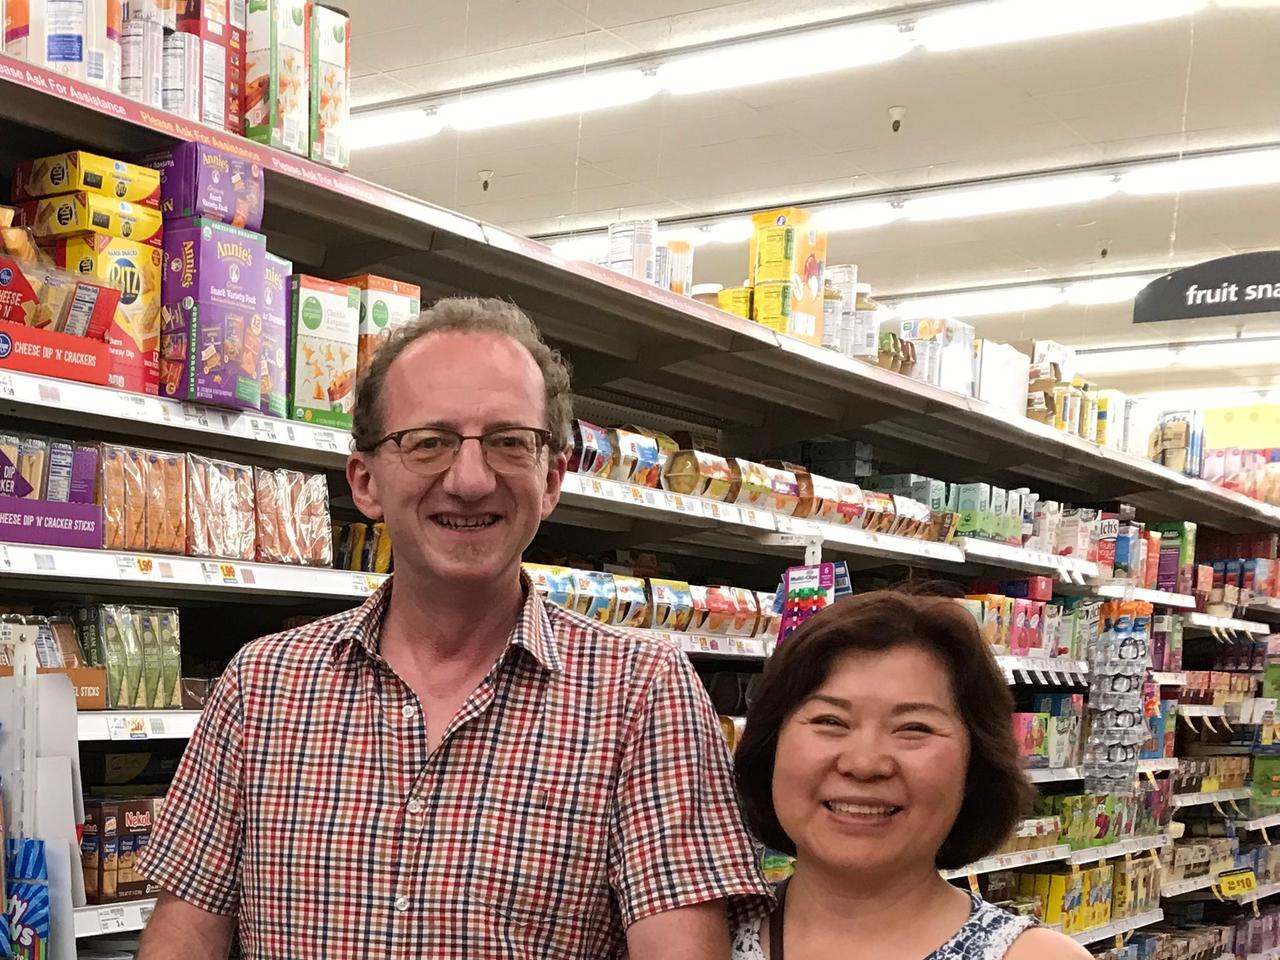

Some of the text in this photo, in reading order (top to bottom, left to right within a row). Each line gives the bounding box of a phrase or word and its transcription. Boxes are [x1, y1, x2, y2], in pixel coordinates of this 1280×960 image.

[26, 68, 48, 88] Ask
[48, 74, 67, 95] For
[69, 83, 127, 117] Assistance
[140, 109, 170, 133] Please
[173, 120, 194, 140] Ask
[210, 133, 261, 163] Assistance
[202, 152, 230, 173] Annie's
[183, 240, 198, 288] Annie's
[216, 240, 253, 267] Annie's
[1186, 283, 1237, 306] fruit
[14, 342, 41, 358] CHEESE
[42, 347, 54, 358] DIP
[64, 351, 96, 367] CRACKERS
[3, 465, 16, 479] DIP
[23, 514, 35, 527] DIP
[43, 516, 73, 530] CRACKER
[73, 519, 95, 533] STICKS
[80, 686, 100, 697] STICKS
